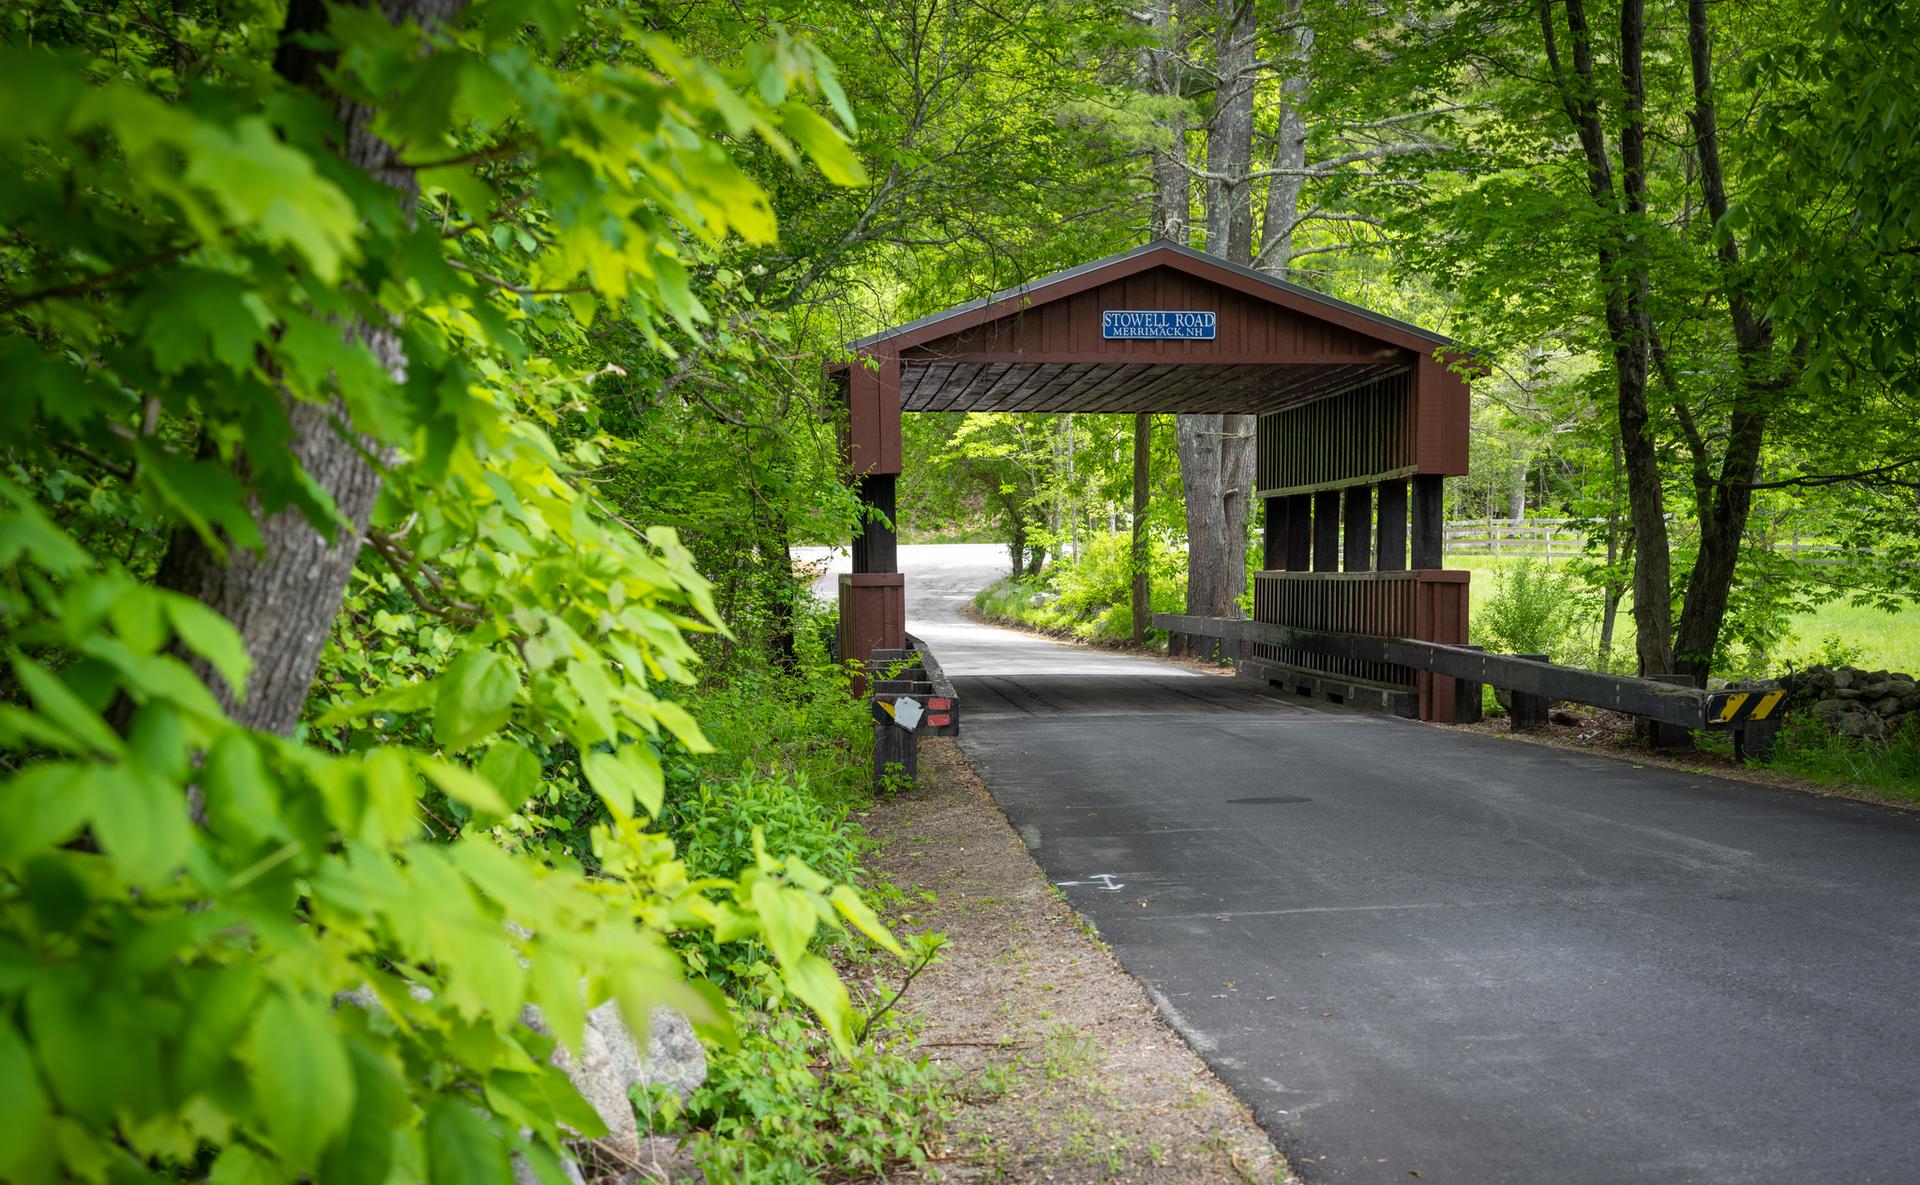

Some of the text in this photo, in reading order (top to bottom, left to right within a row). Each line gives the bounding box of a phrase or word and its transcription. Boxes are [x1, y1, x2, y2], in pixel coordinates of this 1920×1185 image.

[1105, 313, 1214, 327] STOWELL ROAD
[1113, 328, 1203, 337] MERRIMACK, NH
